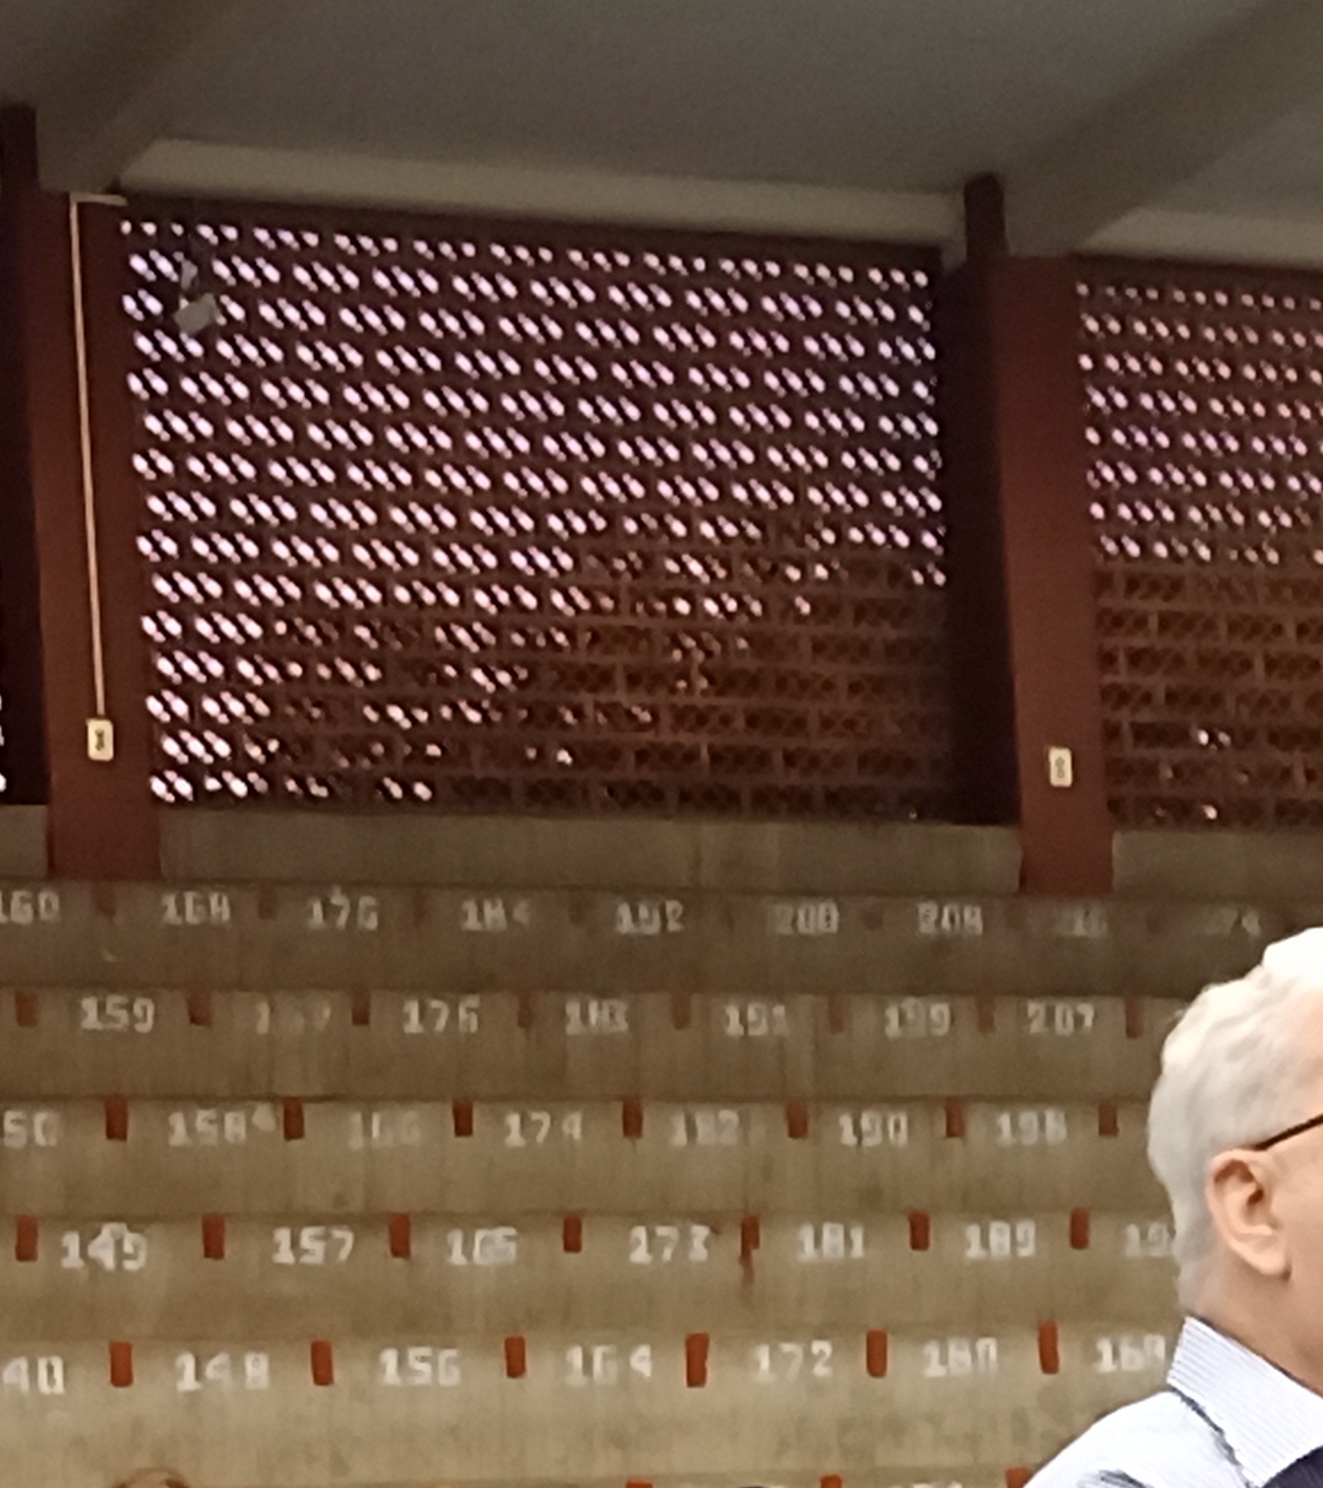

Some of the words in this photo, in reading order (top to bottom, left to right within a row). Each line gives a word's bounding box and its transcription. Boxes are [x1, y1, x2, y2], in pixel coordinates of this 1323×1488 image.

[80, 994, 155, 1034] 159
[1027, 1002, 1095, 1036] 207
[504, 1110, 583, 1148] 174
[272, 1226, 354, 1265] 157
[796, 1221, 865, 1262] 181
[964, 1219, 1037, 1259] 189
[1124, 1222, 1174, 1259] 19
[174, 1351, 270, 1392] 148
[379, 1345, 461, 1387] 156
[749, 1339, 835, 1385] 172
